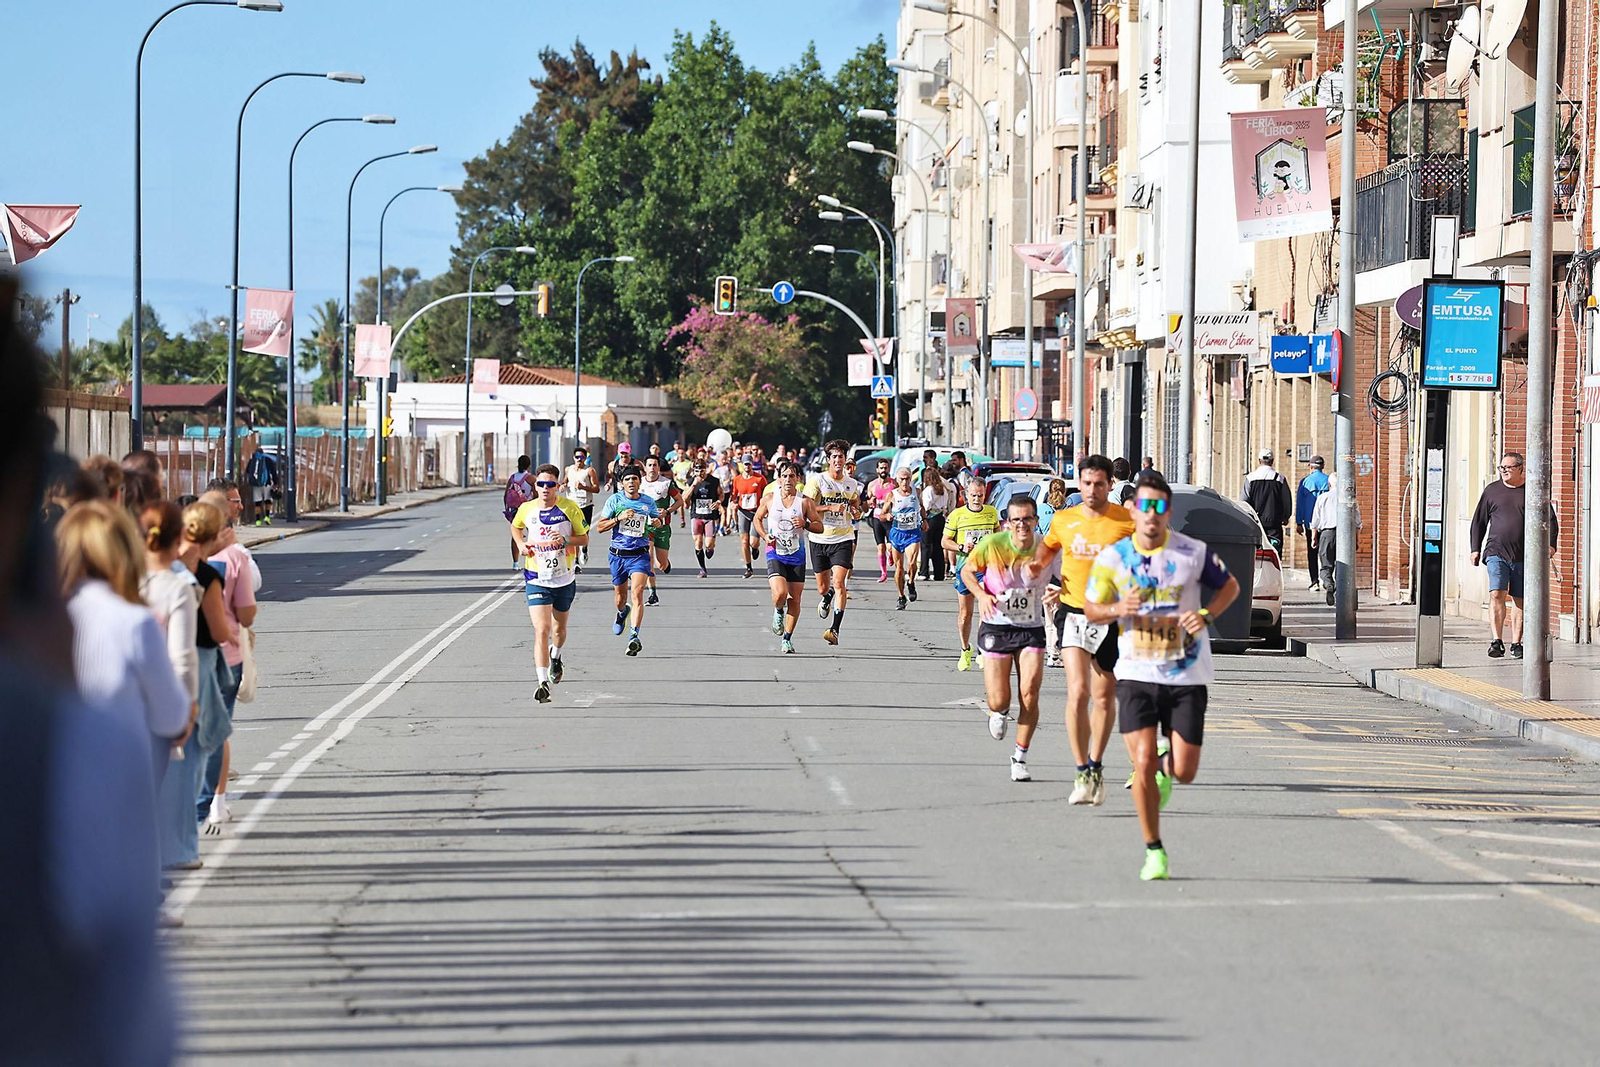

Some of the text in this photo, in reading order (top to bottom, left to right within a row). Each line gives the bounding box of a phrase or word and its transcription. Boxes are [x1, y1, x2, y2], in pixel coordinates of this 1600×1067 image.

[1246, 118, 1275, 128] FERIA
[1265, 125, 1295, 136] LIBRO
[1254, 201, 1312, 216] HUELVA
[250, 308, 279, 320] FERIA
[1432, 304, 1493, 316] EMTUSA
[1199, 331, 1227, 349] Carmen
[1274, 349, 1302, 360] pelayo
[1066, 464, 1074, 474] P
[625, 519, 641, 529] 209
[781, 539, 793, 548] 33
[545, 557, 559, 569] 29
[1005, 597, 1028, 611] 149
[1138, 627, 1177, 642] 1116
